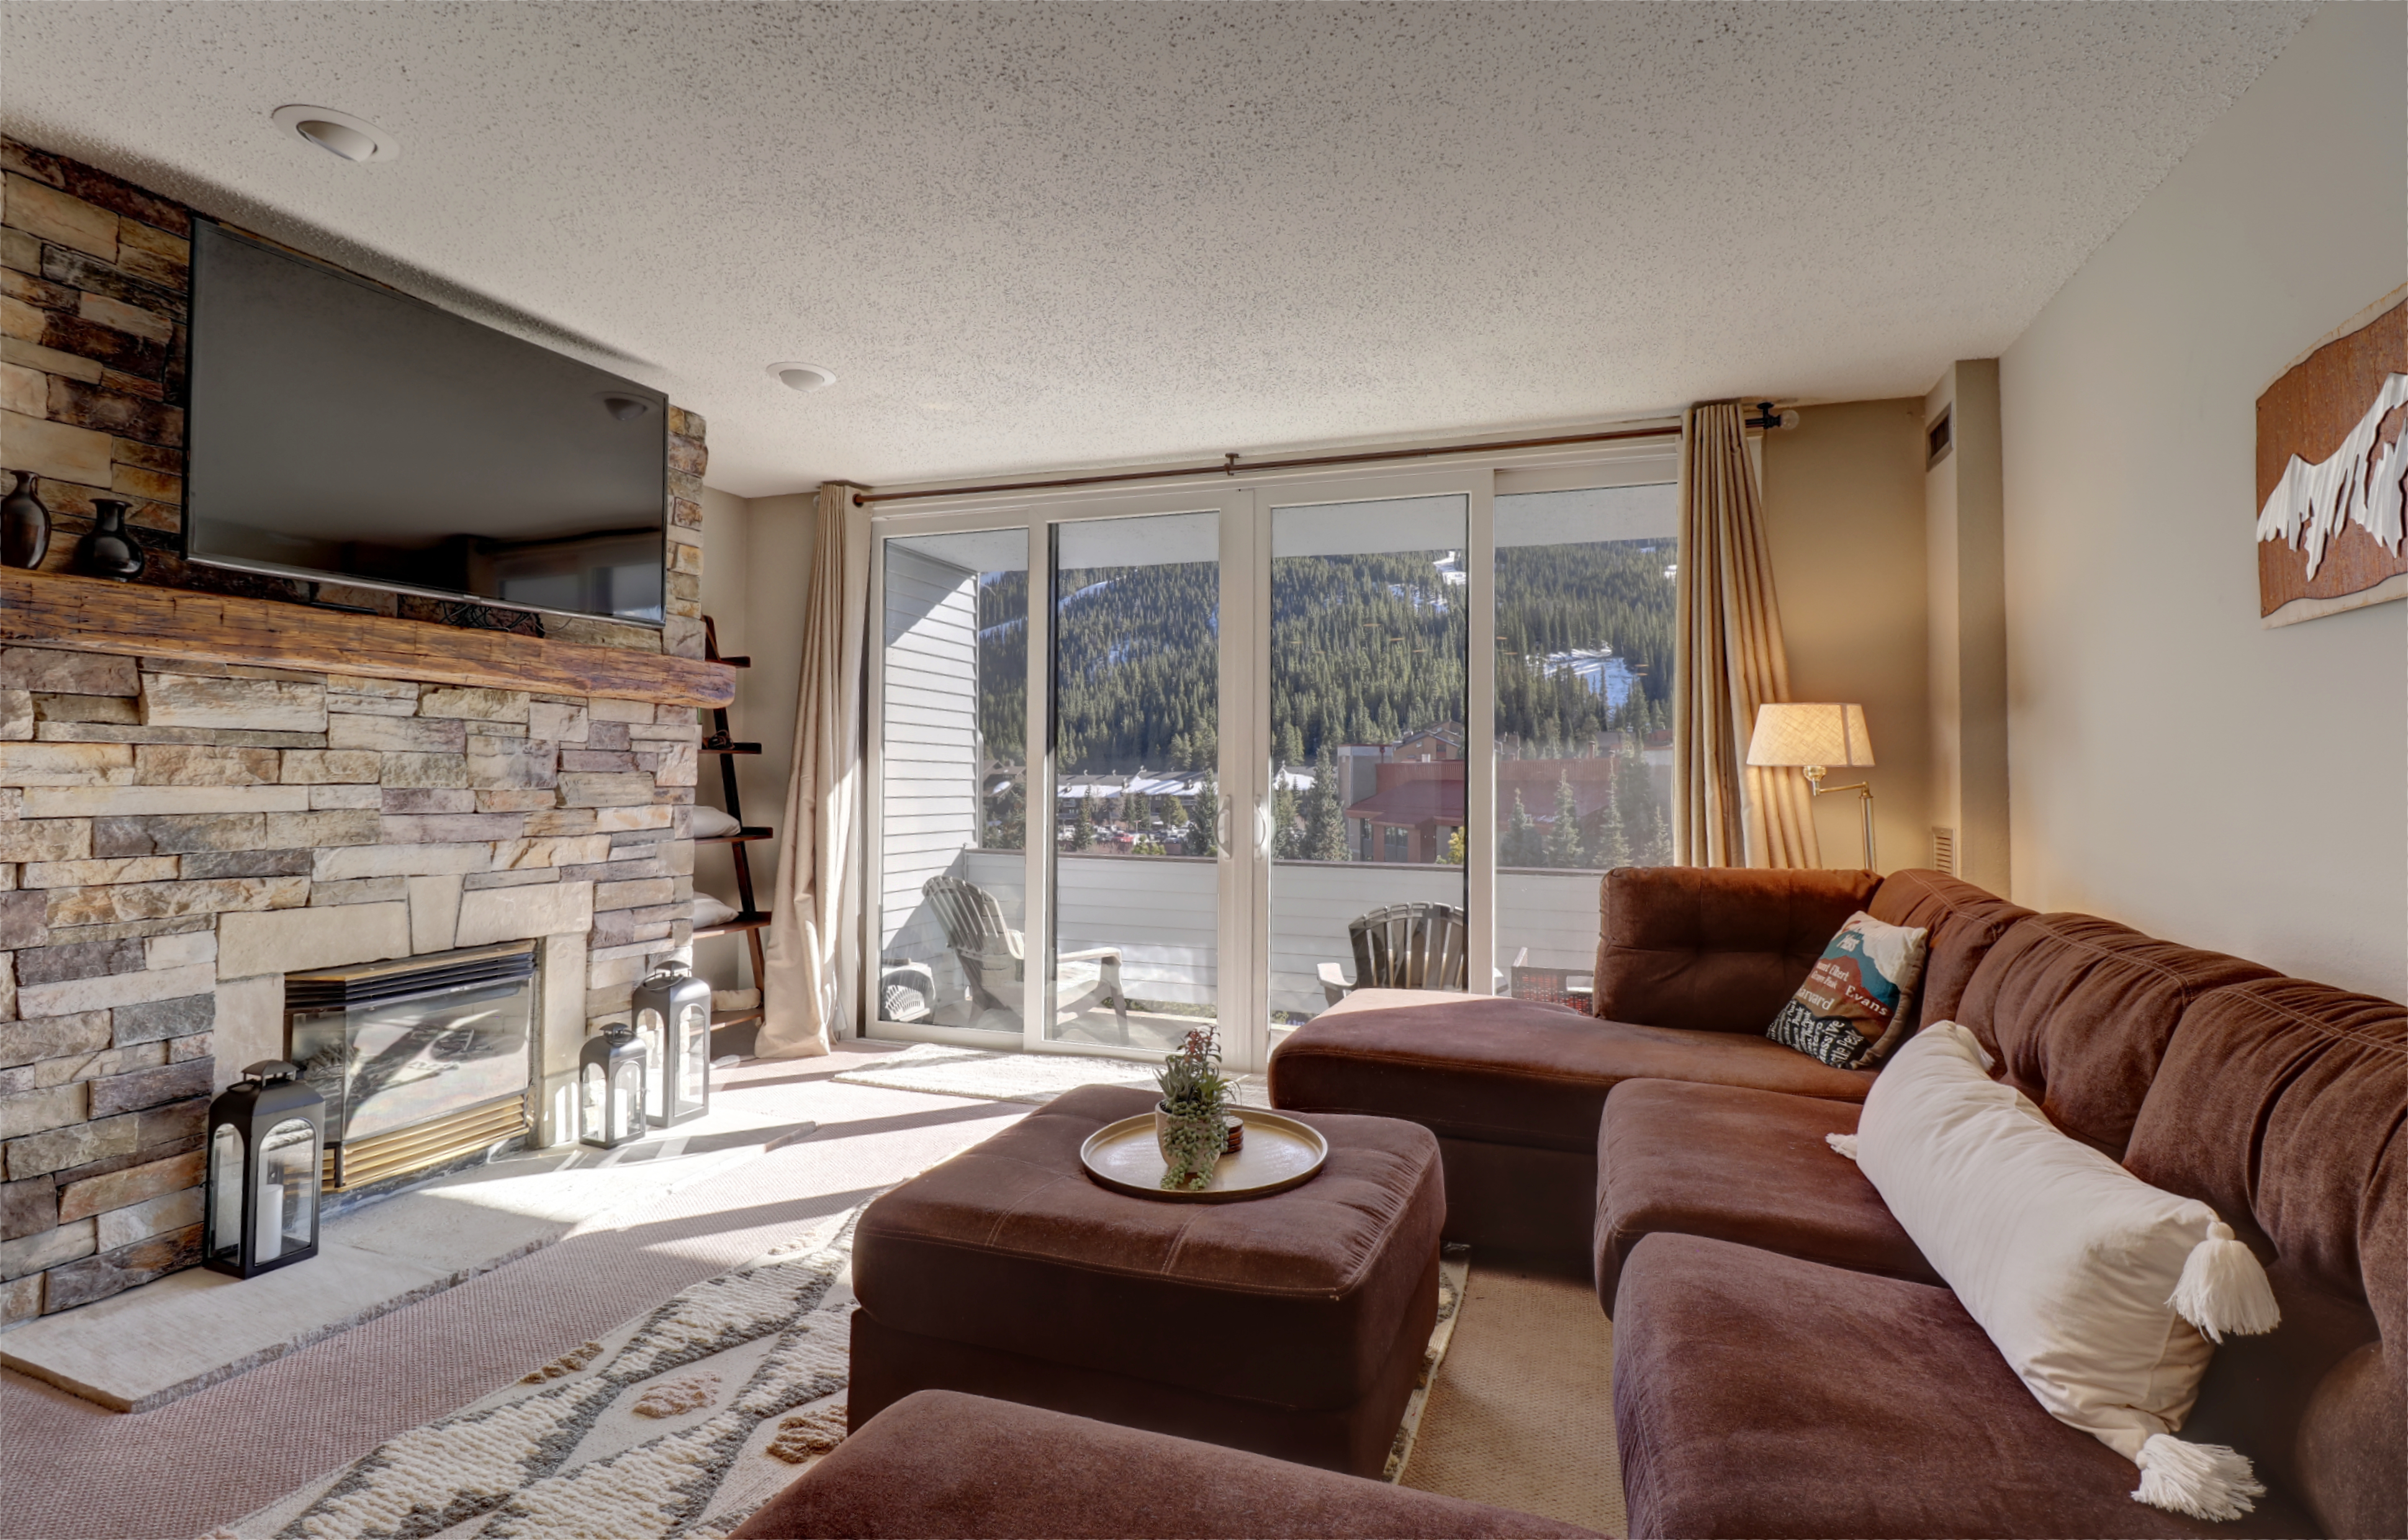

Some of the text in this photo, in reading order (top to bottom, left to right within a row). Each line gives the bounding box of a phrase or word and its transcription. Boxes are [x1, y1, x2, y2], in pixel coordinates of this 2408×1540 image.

[1829, 965, 1850, 982] Elbert
[1845, 984, 1888, 1016] Evans
[1792, 1007, 1805, 1026] Peak
[1801, 1011, 1812, 1027] Peak
[1805, 1020, 1816, 1037] Peak
[1812, 1022, 1823, 1059] ntero
[1829, 1029, 1865, 1068] astle Peak
